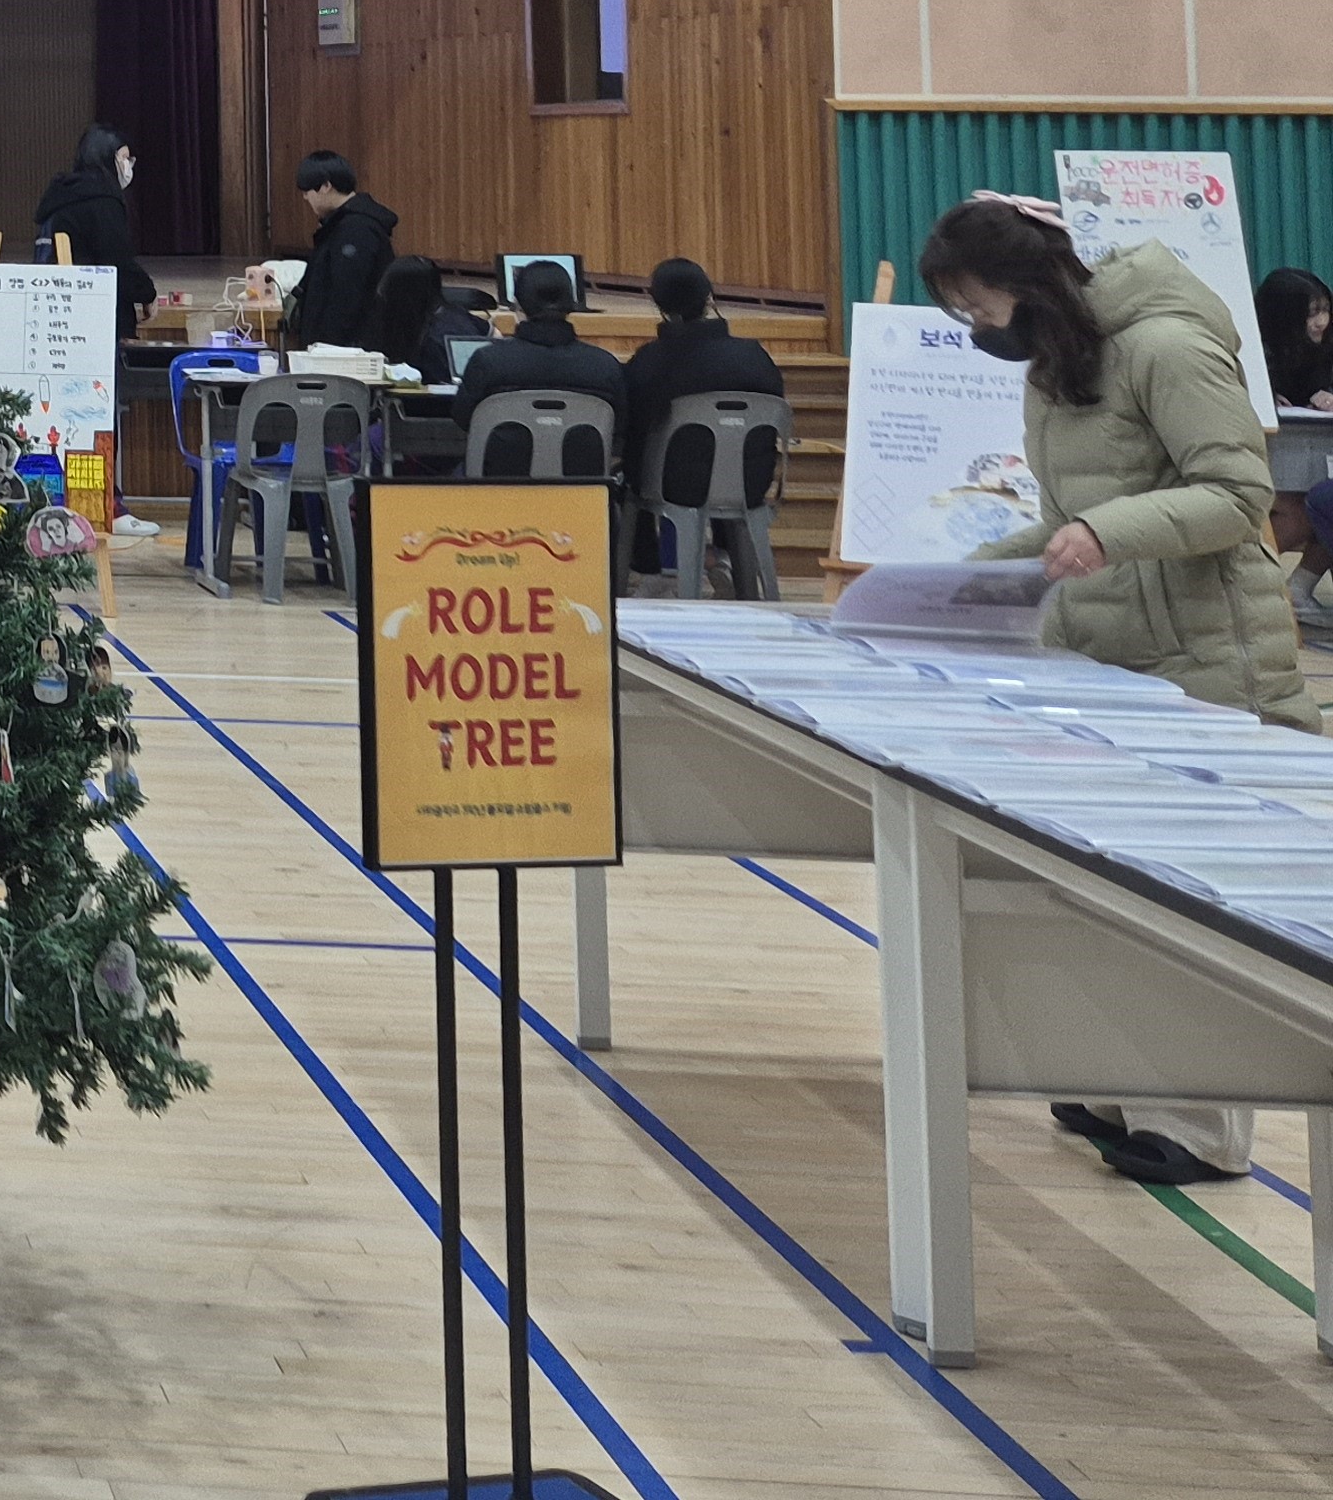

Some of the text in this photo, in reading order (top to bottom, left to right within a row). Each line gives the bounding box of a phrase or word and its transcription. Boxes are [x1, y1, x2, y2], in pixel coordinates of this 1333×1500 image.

[919, 328, 963, 349] 보석
[456, 551, 497, 567] Dream
[426, 586, 556, 636] ROLE
[404, 651, 582, 703] MODEL
[428, 717, 558, 772] TREE
